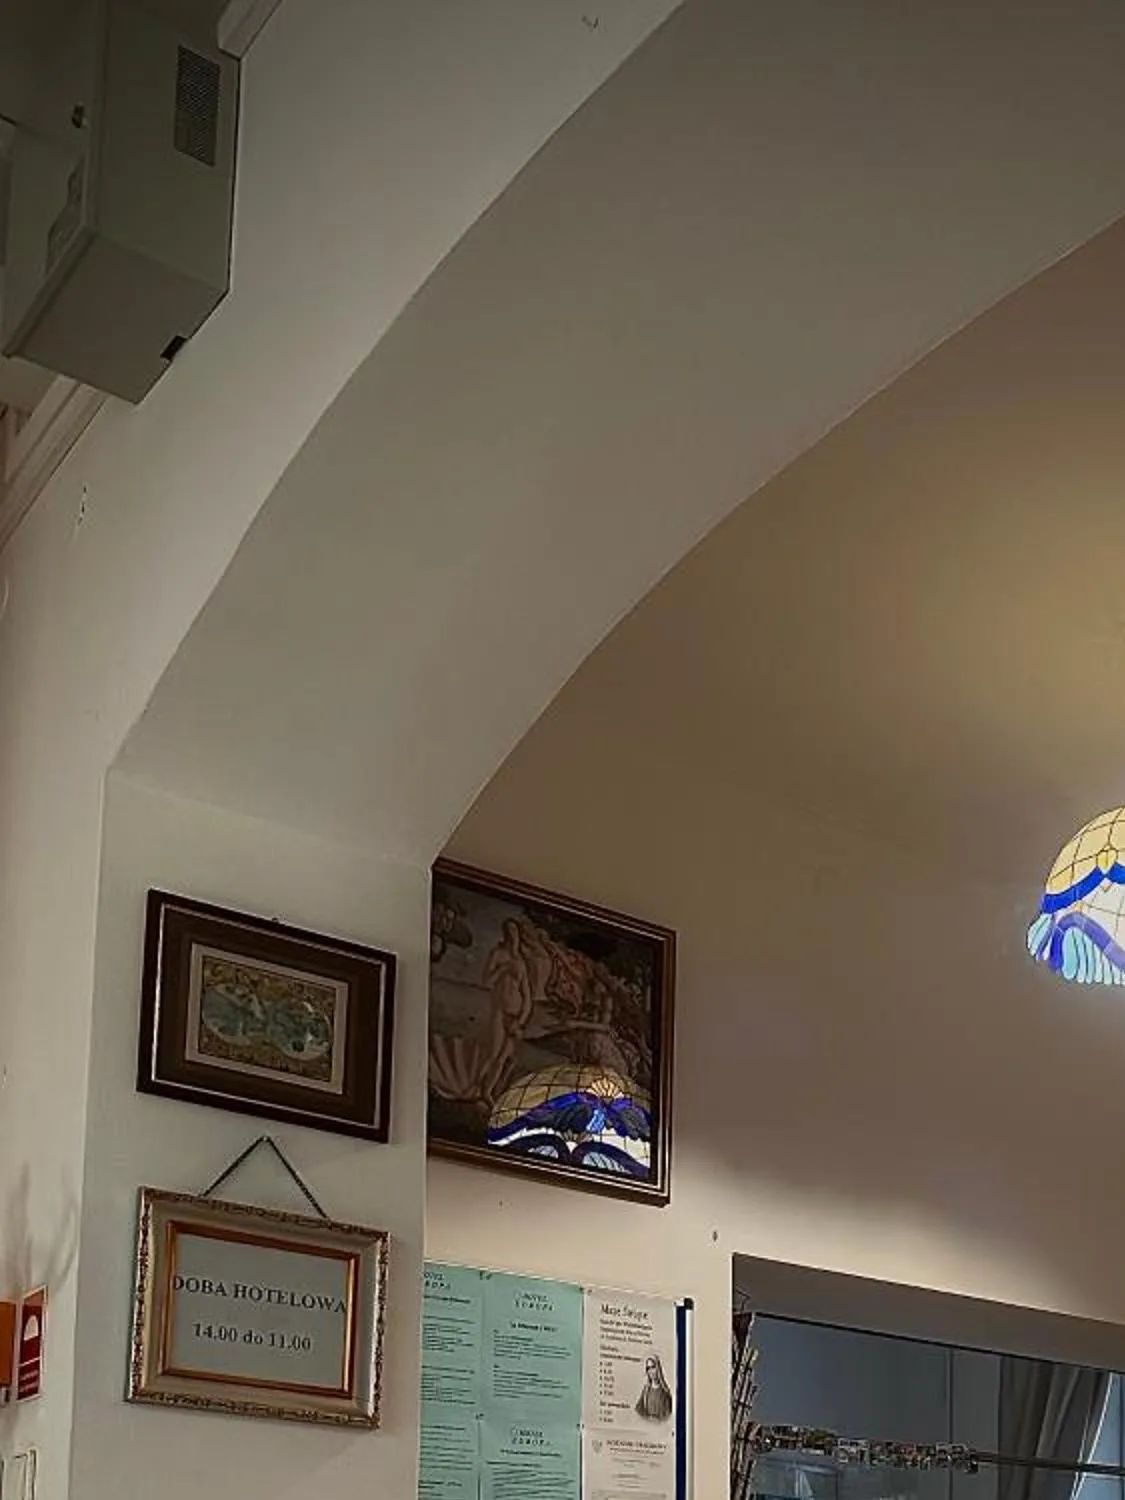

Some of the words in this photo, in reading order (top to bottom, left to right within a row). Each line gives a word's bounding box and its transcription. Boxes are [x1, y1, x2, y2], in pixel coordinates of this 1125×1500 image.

[174, 1276, 227, 1297] DOBA
[233, 1282, 347, 1313] HOTELOWA
[193, 1323, 239, 1343] 14.00
[243, 1329, 264, 1346] do
[269, 1332, 312, 1351] 11.00
